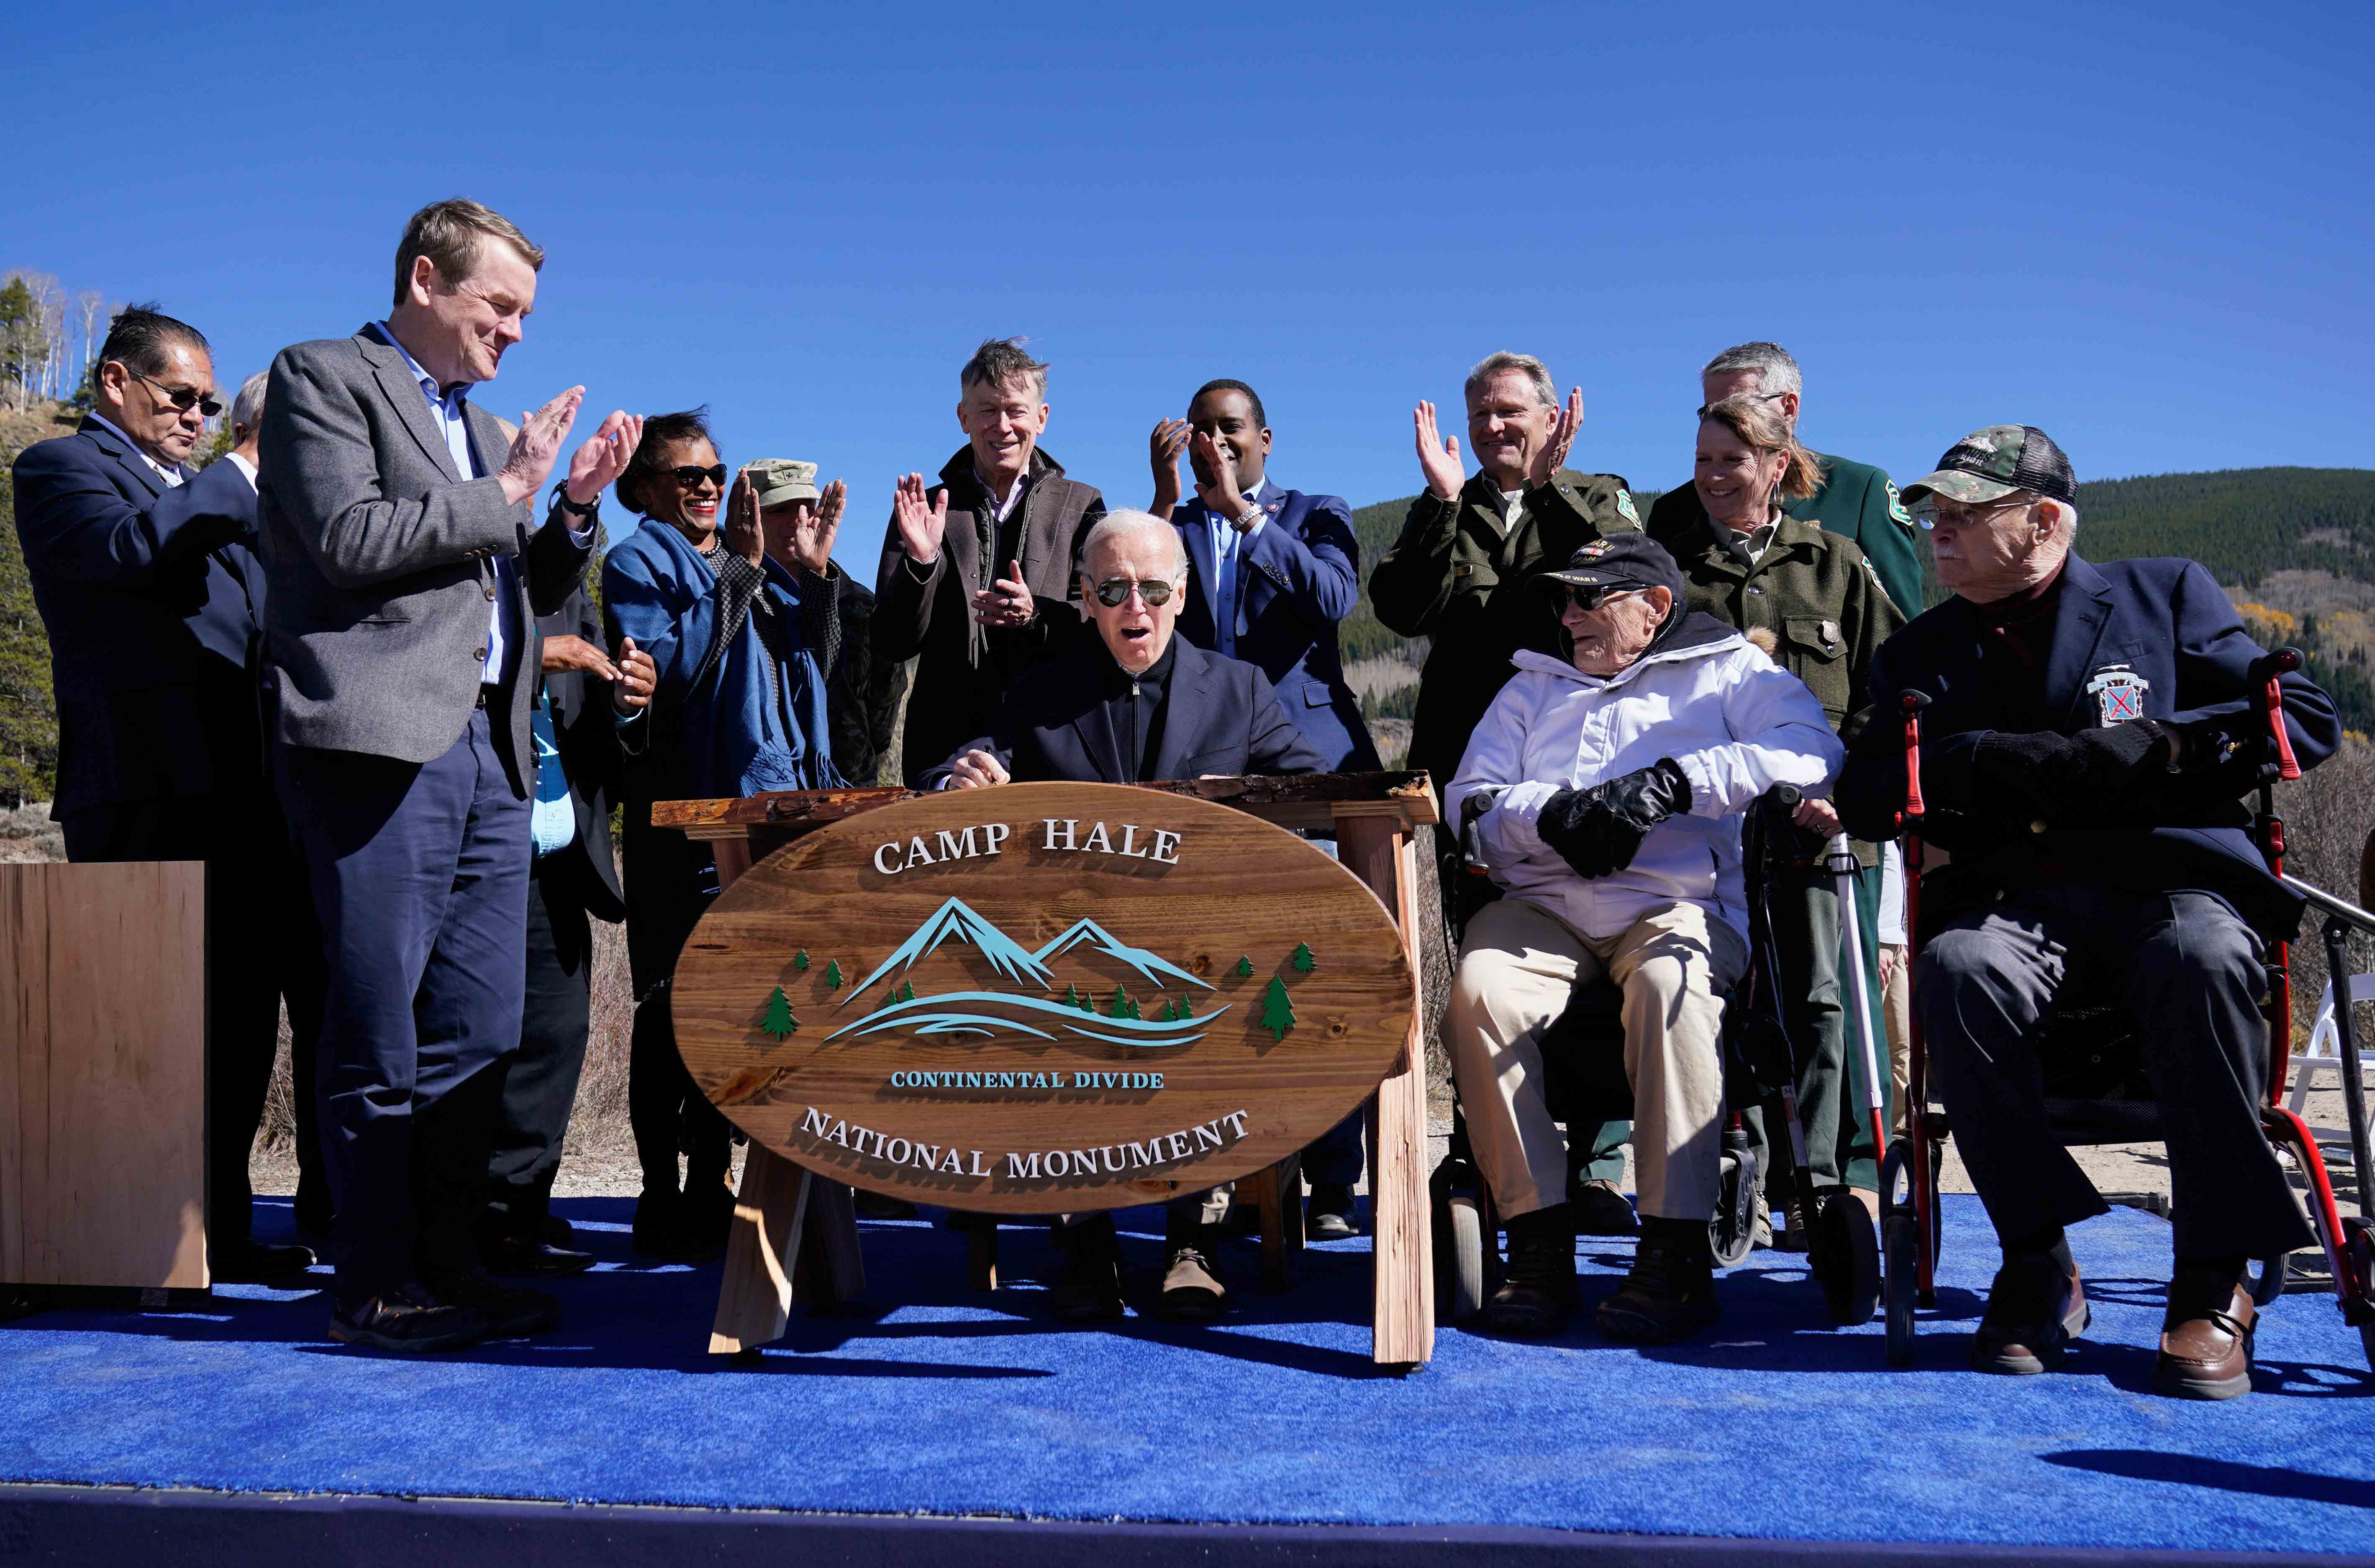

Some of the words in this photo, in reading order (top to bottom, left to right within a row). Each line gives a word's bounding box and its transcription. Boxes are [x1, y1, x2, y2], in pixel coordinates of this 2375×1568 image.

[874, 822, 1010, 874] CAMP
[1042, 819, 1181, 865] HALE
[891, 1071, 1064, 1088] CONTINENTAL
[1074, 1072, 1164, 1089] DIVIDE
[800, 1107, 992, 1177] NATIONAL
[1006, 1109, 1249, 1179] MONUMENT
